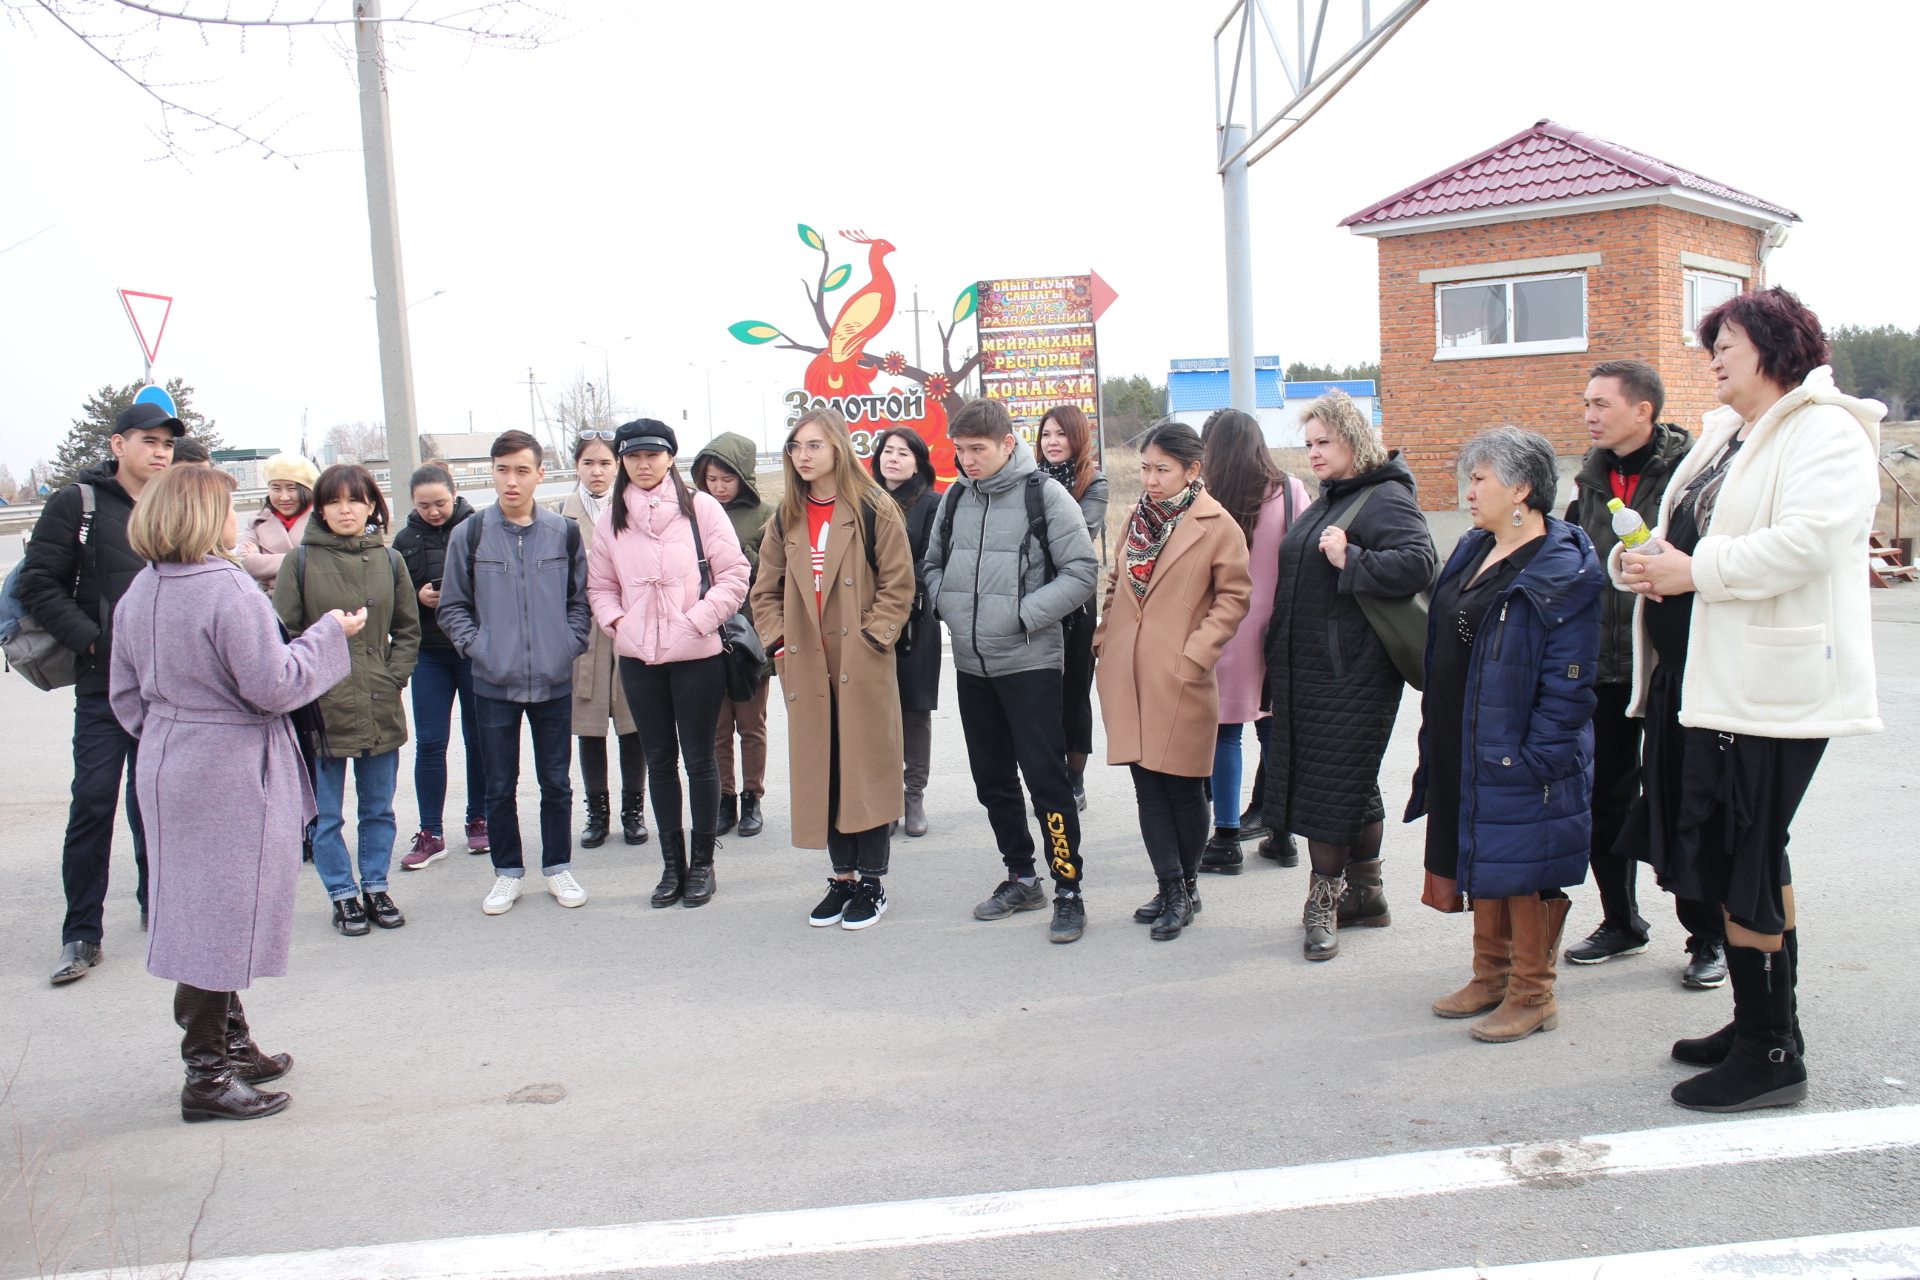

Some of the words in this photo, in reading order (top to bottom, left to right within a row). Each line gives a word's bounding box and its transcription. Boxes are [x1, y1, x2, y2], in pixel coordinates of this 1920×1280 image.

[993, 280, 1030, 292] ОЙЫН
[1033, 278, 1075, 290] САУЫҚ
[1005, 289, 1063, 301] САЯБАҒЫ
[983, 309, 1088, 327] РАЗВЛЕЧЕНИЙ
[1015, 303, 1055, 315] ПАРК
[982, 334, 1093, 352] МЕЙРАМХАНА
[994, 352, 1081, 370] РЕСТОРАН
[1001, 398, 1096, 417] СТИНА
